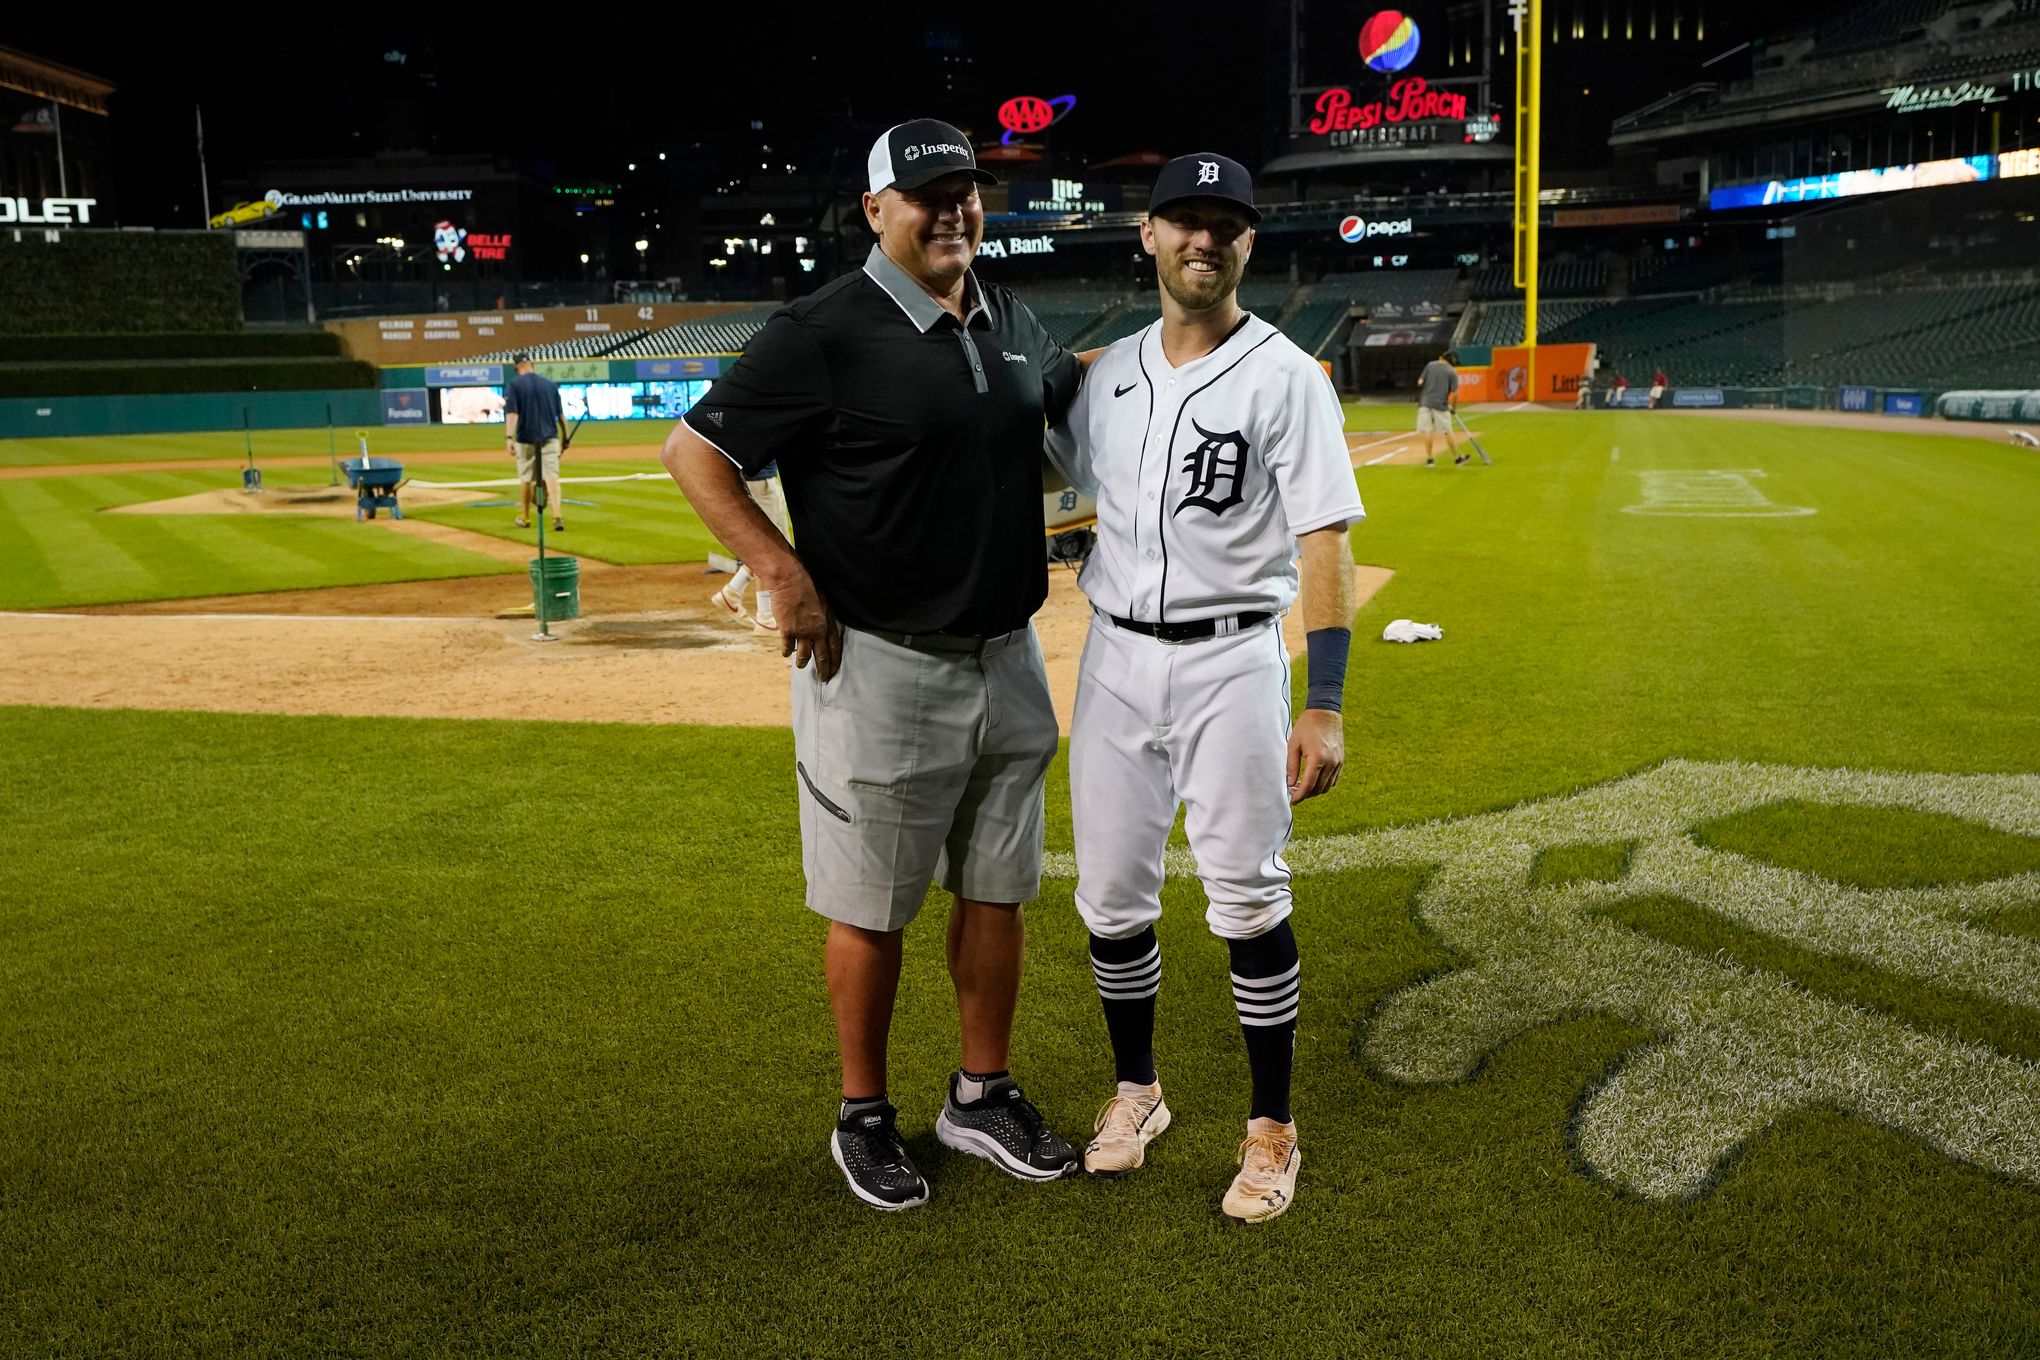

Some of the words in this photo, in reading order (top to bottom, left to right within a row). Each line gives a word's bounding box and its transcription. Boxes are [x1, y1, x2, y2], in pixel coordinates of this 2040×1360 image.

[1003, 99, 1049, 130] AAA
[1310, 88, 1382, 135] PEPSI
[1385, 77, 1467, 122] PORCH
[920, 143, 971, 161] Insperity
[1196, 160, 1221, 187] D
[1052, 178, 1084, 201] Lite
[1028, 200, 1083, 212] PITCHER'S
[1084, 202, 1105, 212] PUB
[1366, 217, 1412, 238] pepsi
[466, 233, 512, 247] BELLE
[1009, 235, 1056, 255] Bank
[472, 246, 506, 260] TIRE
[586, 308, 599, 323] 11
[637, 306, 654, 321] 42
[1172, 417, 1251, 519] D
